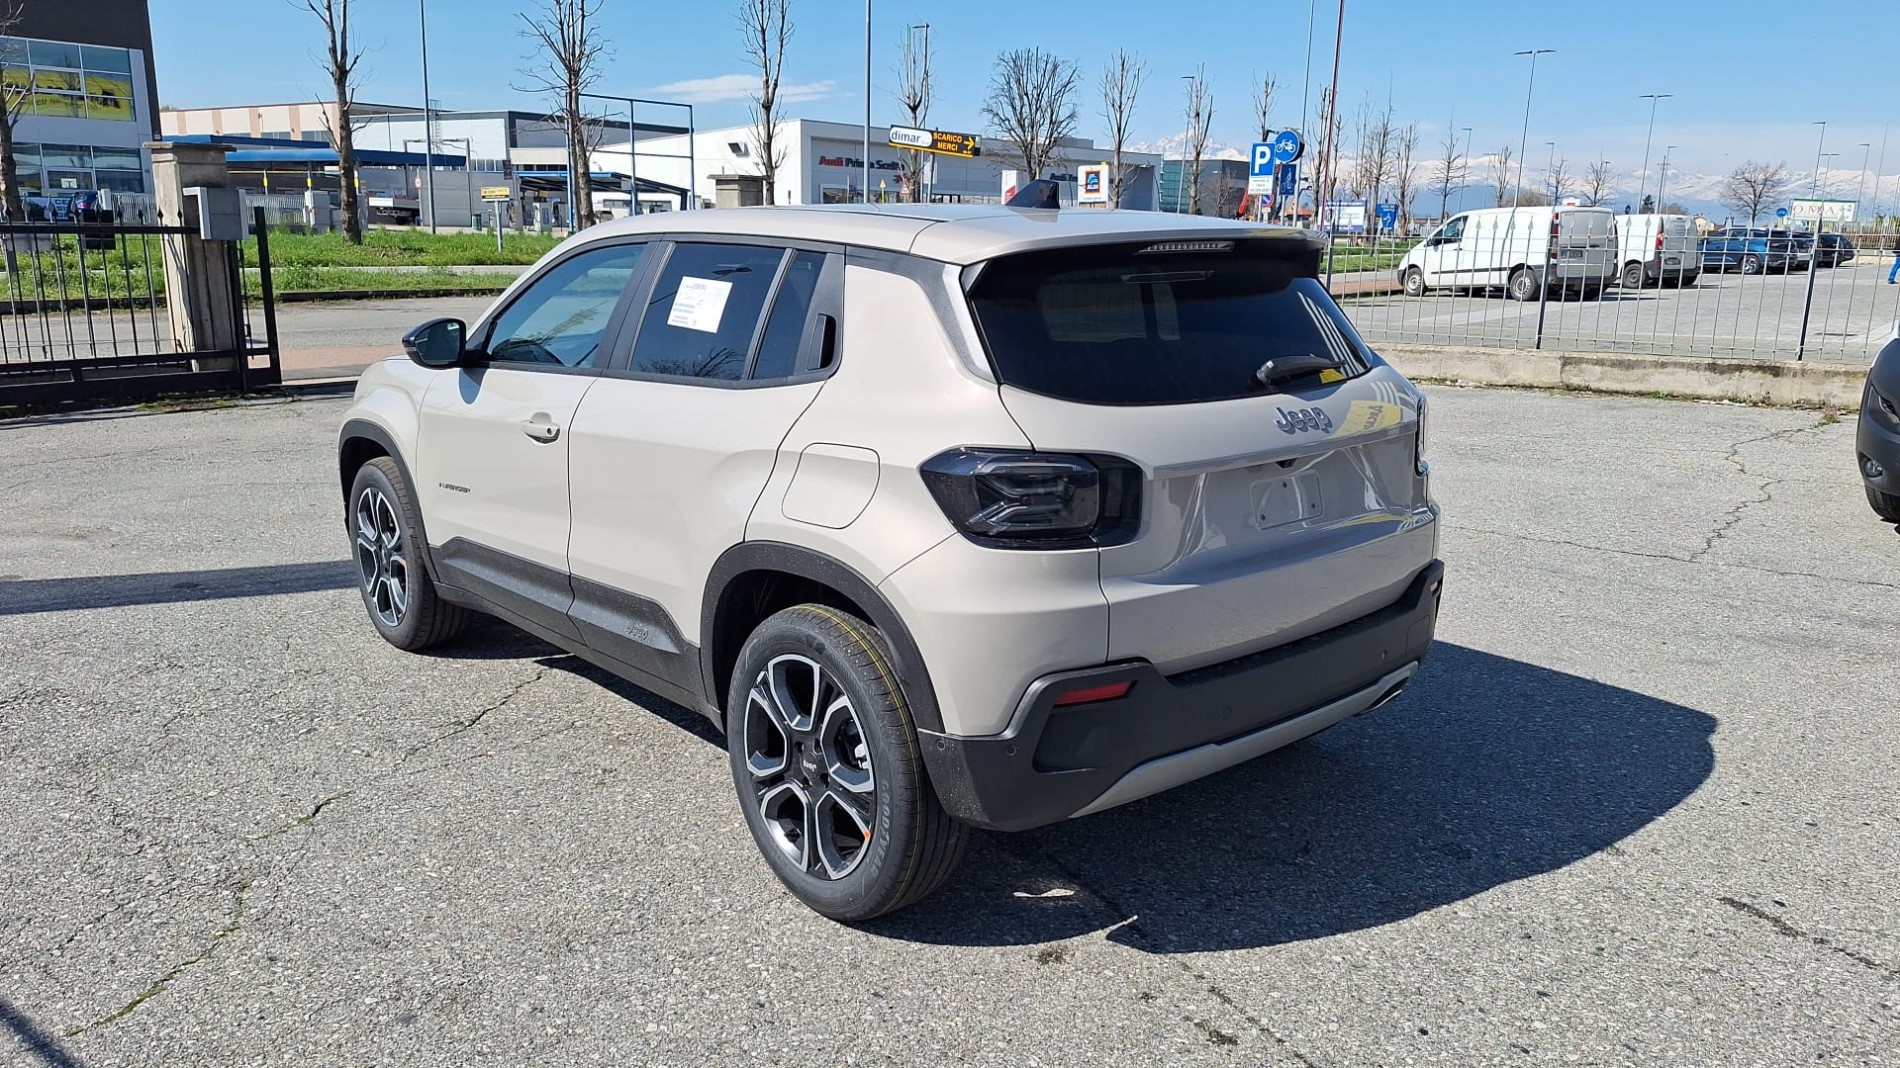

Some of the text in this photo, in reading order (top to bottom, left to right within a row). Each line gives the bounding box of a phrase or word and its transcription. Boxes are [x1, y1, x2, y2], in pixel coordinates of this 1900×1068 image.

[891, 130, 921, 143] dimar
[933, 132, 962, 142] SCARICO
[937, 142, 958, 151] MERCI
[818, 156, 843, 167] Audi
[1254, 146, 1271, 173] P
[1273, 406, 1333, 435] Jeep
